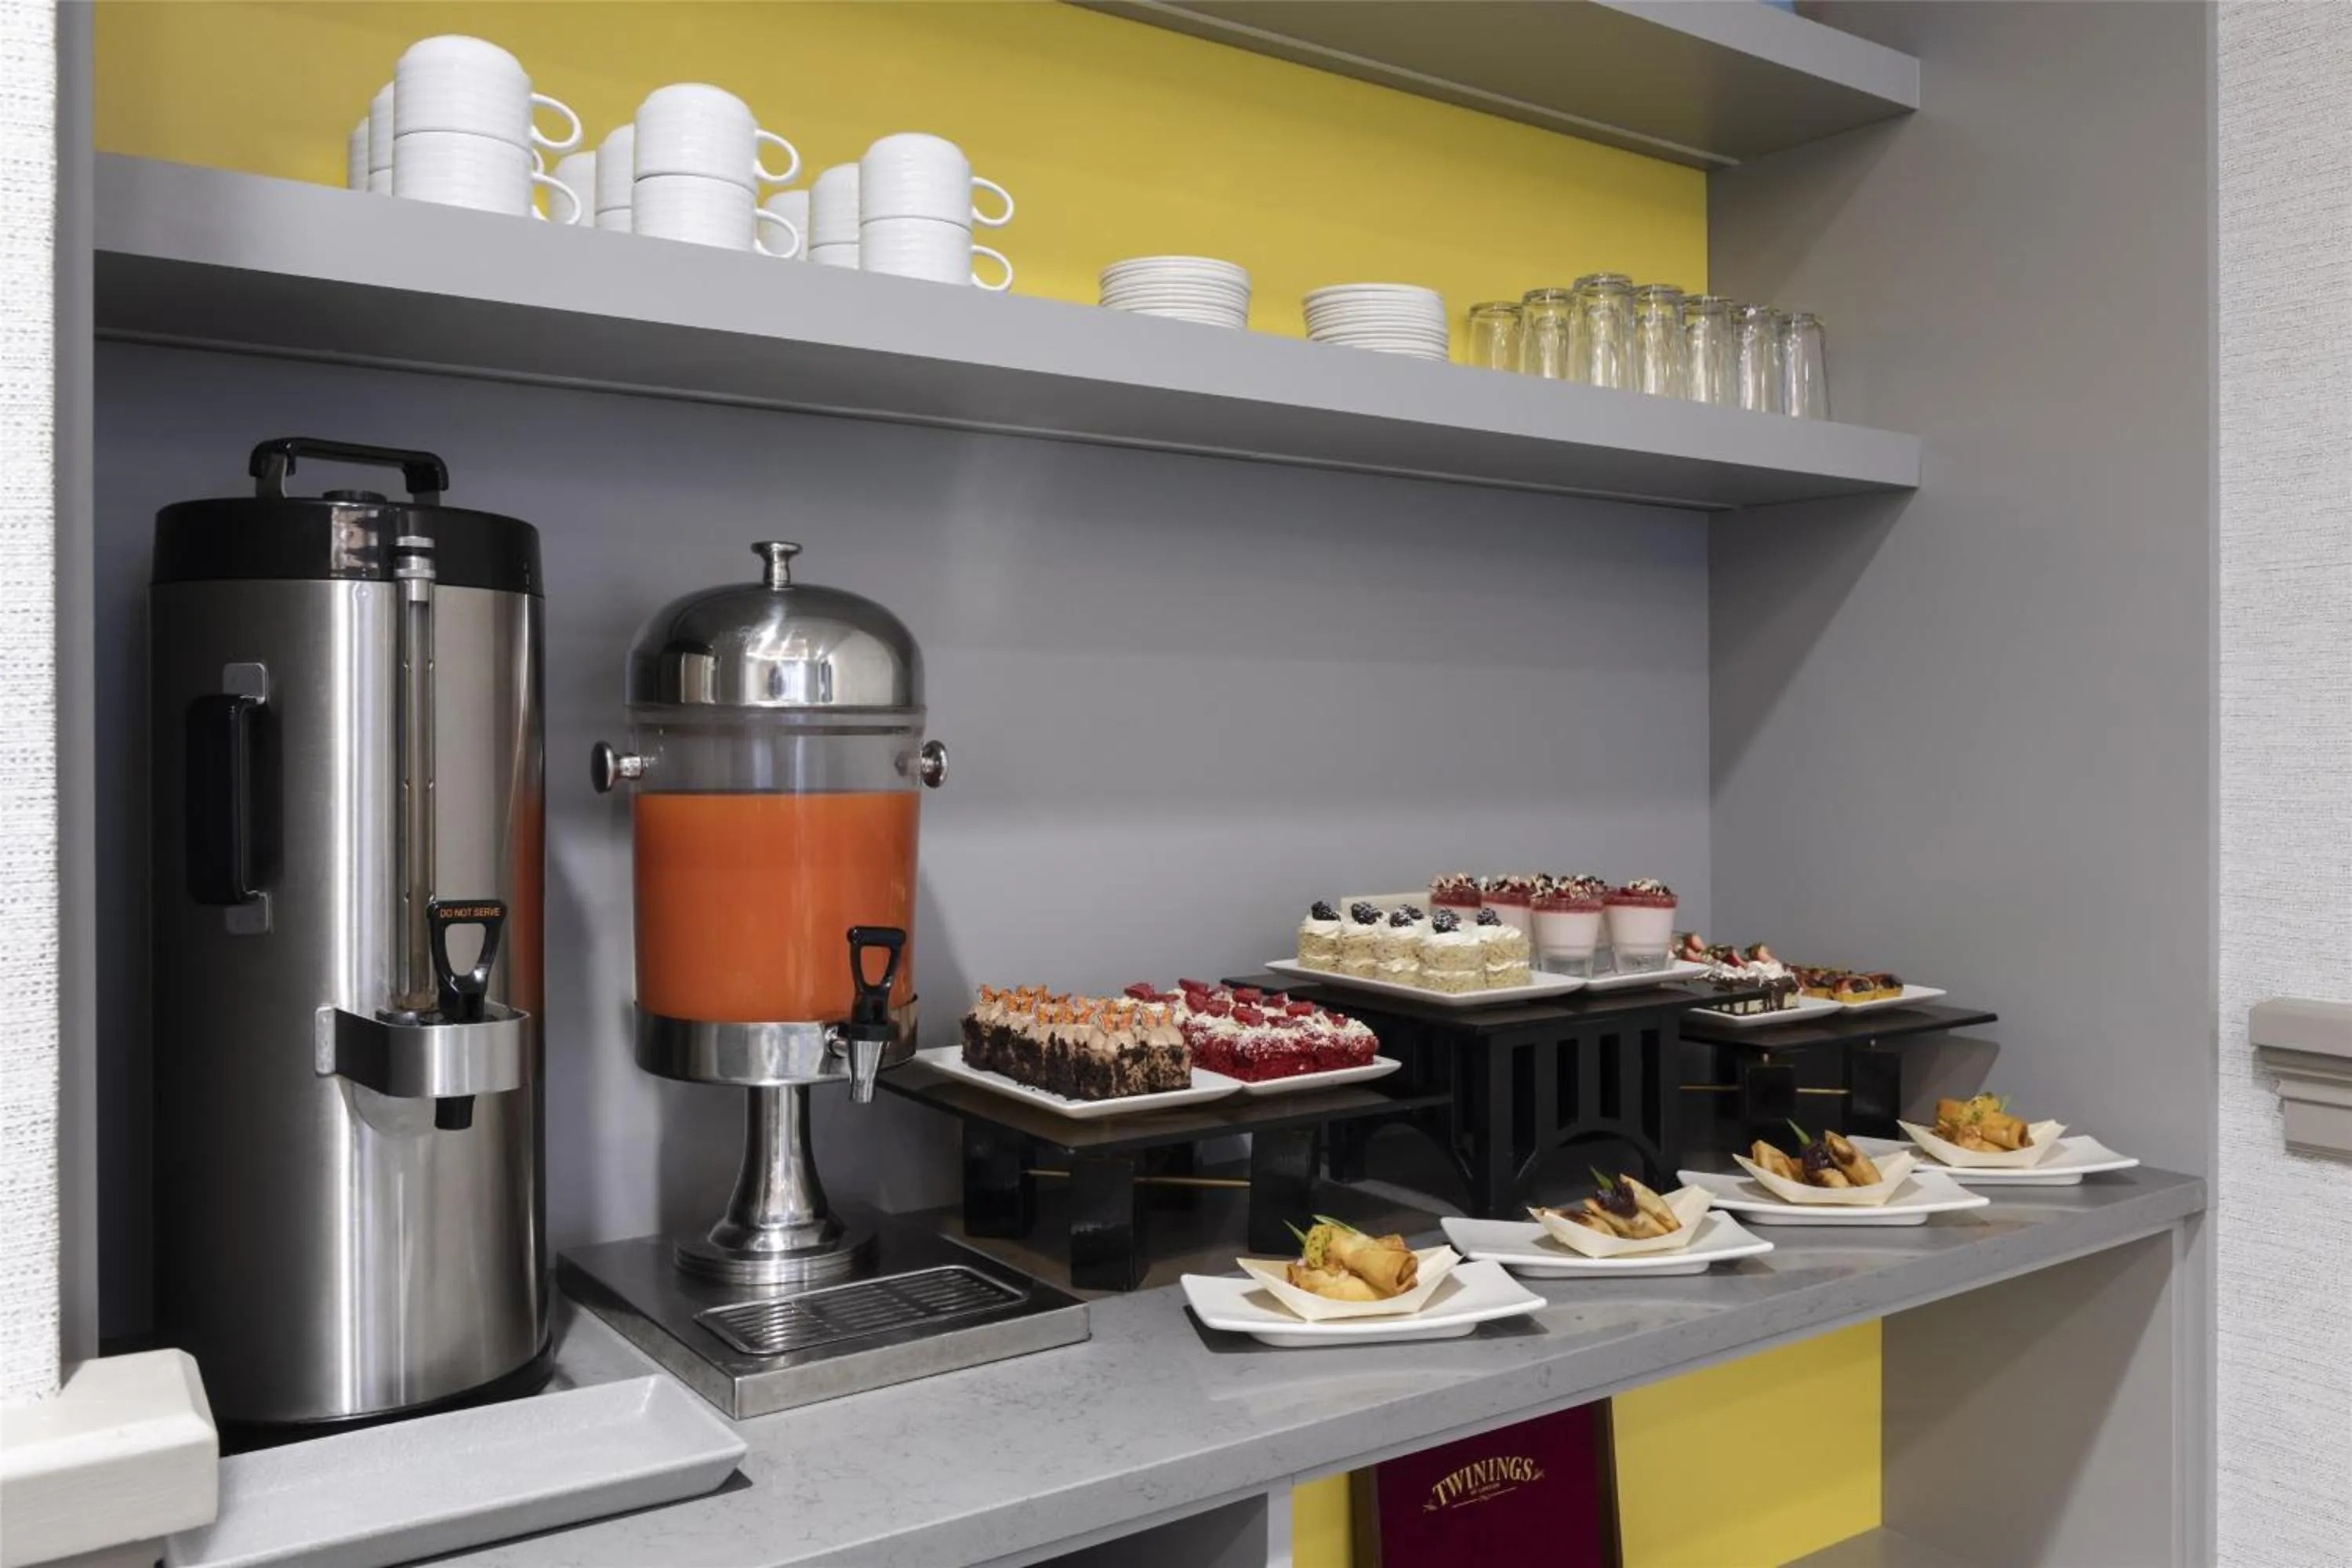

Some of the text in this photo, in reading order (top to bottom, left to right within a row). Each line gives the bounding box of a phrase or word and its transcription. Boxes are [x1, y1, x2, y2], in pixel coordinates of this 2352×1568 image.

[440, 907, 501, 918] DO NOT SERVE
[1432, 1456, 1534, 1506] TWININGS
